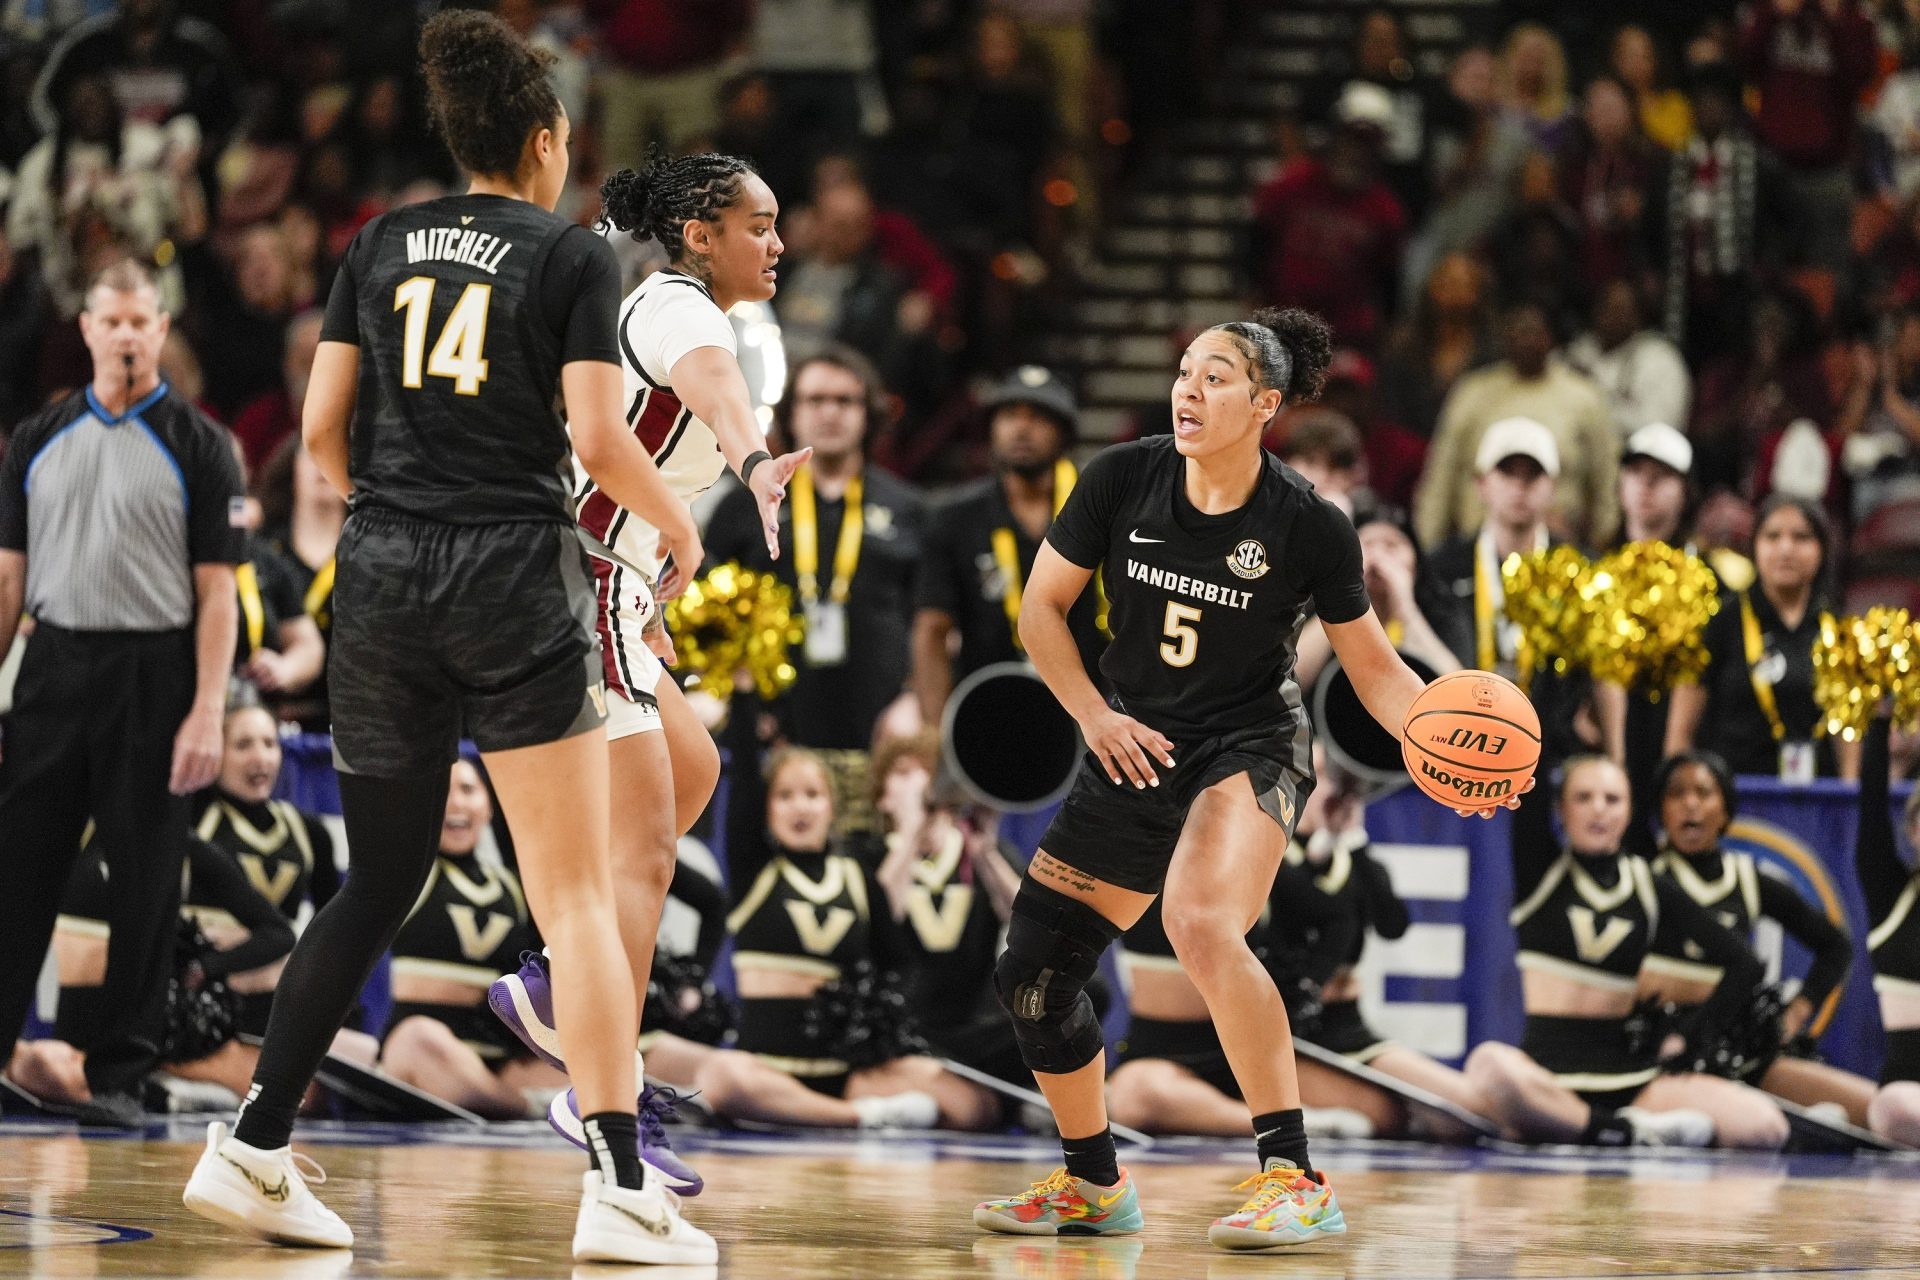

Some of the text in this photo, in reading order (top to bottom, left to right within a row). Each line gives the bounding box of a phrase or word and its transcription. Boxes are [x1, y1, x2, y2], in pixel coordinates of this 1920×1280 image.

[406, 227, 512, 275] MITCHELL
[393, 275, 492, 397] 14
[1230, 562, 1263, 578] GRADUATE
[1236, 541, 1264, 569] SEC
[1127, 558, 1254, 611] VANDERBILT
[1159, 600, 1203, 668] 5
[1430, 734, 1448, 744] NXT
[1421, 759, 1513, 799] Wilson
[1276, 786, 1295, 826] V
[445, 903, 514, 961] V
[785, 899, 857, 955] V
[909, 883, 973, 953] V
[1566, 904, 1634, 962] V
